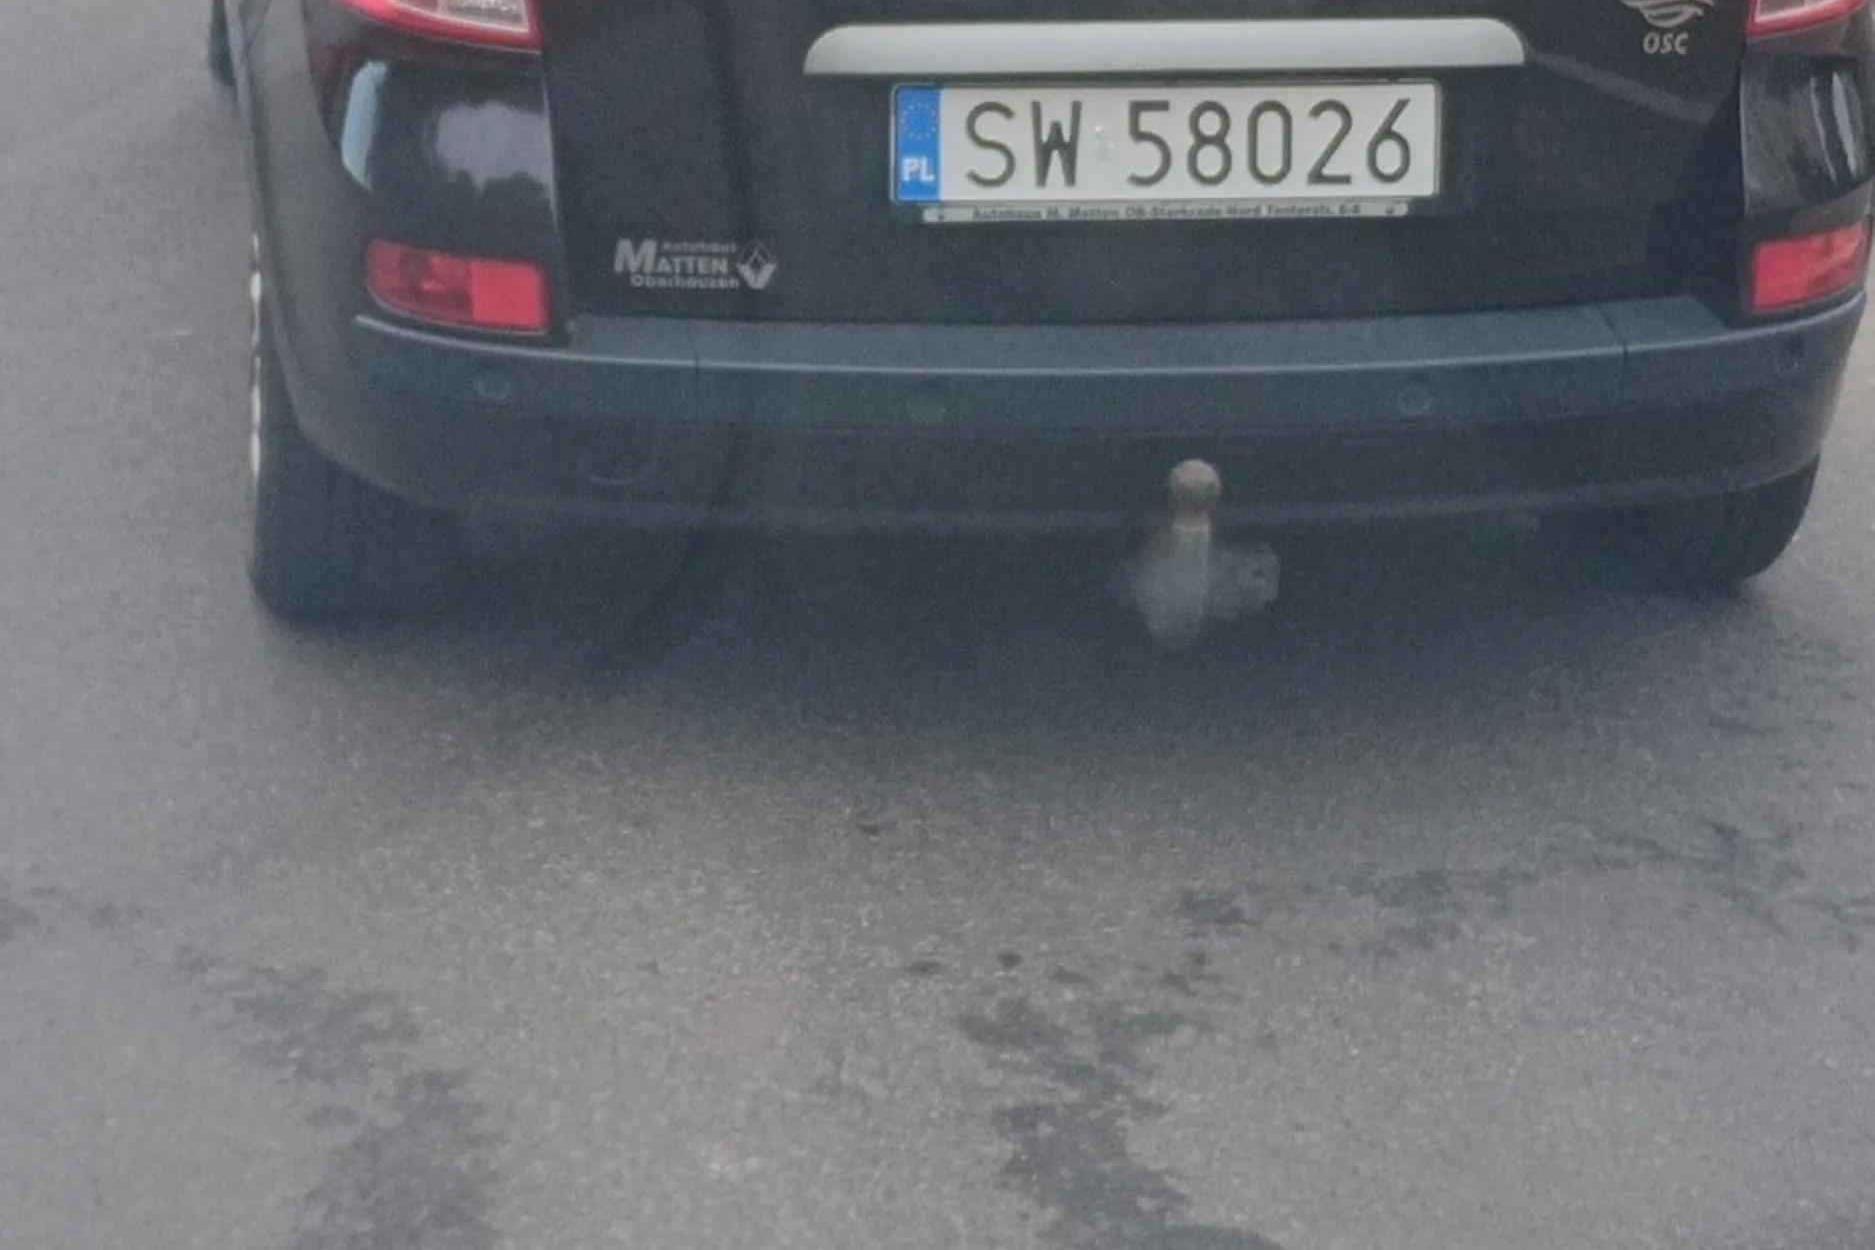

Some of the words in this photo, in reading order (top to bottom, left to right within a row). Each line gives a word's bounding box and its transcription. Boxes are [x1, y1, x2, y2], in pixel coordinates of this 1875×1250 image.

[901, 155, 936, 182] PL
[965, 99, 1083, 189] SW
[1126, 97, 1412, 187] 58026
